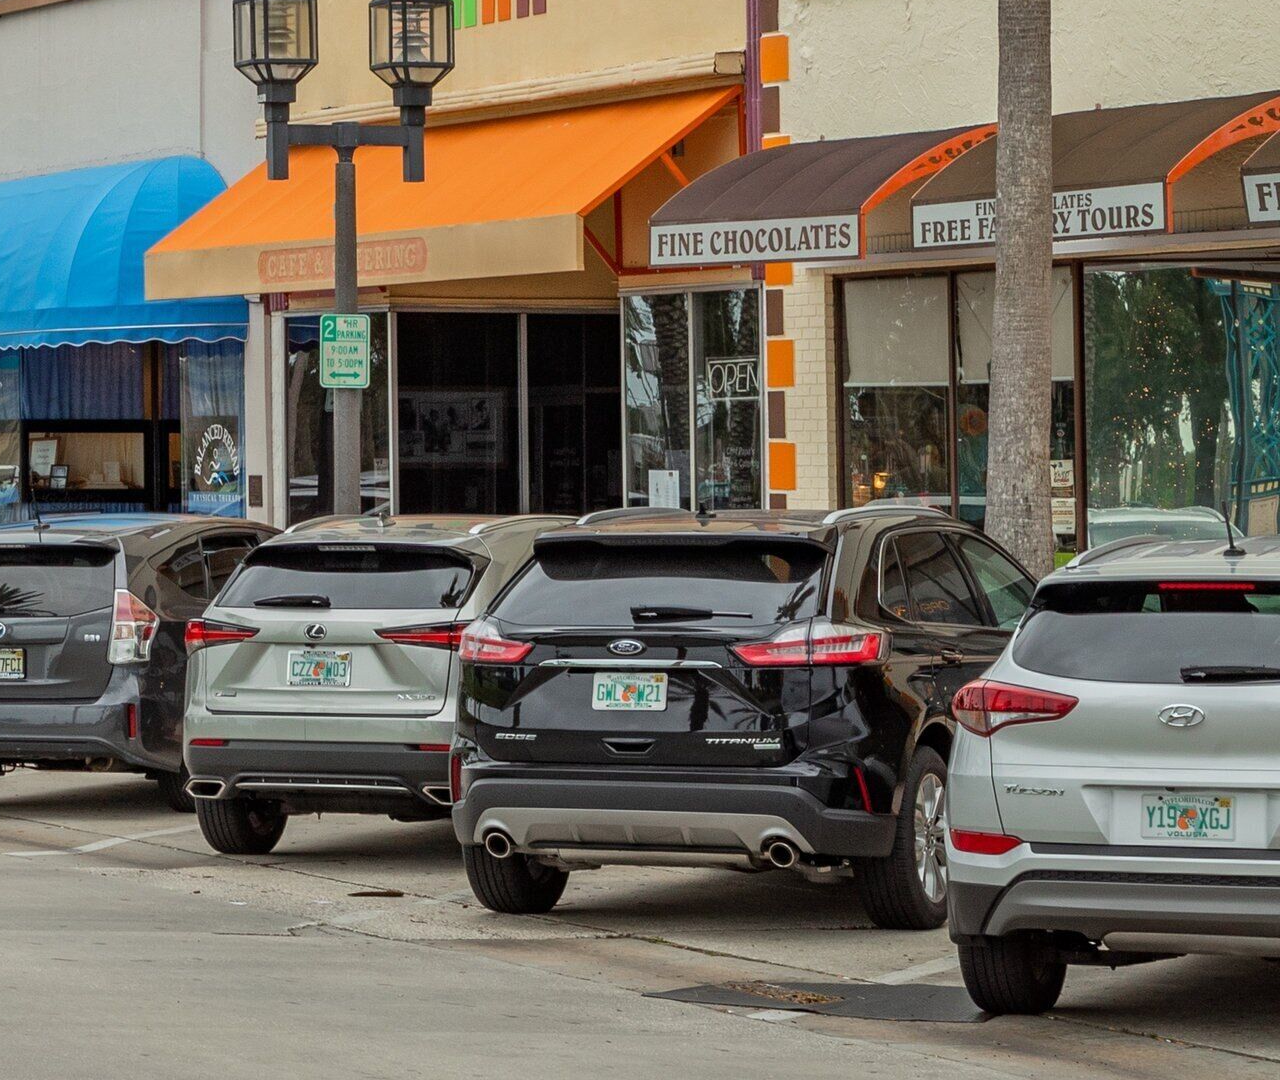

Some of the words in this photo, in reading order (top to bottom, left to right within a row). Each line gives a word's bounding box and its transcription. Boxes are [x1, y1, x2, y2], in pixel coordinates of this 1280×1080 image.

[1255, 181, 1280, 212] F
[975, 201, 996, 217] FIN
[921, 219, 971, 244] FREE
[1077, 203, 1154, 232] TOURS
[657, 232, 704, 258] FINE
[709, 223, 852, 256] CHOCOLATES
[267, 252, 309, 278] CAFE
[324, 320, 335, 338] 2
[346, 319, 359, 328] HR
[337, 330, 366, 340] PARKING
[710, 362, 759, 394] OPEN
[292, 661, 314, 677] CZZ
[326, 662, 346, 677] W03
[597, 683, 620, 701] GWL
[637, 684, 661, 702] W21
[495, 732, 538, 741] EDGE
[705, 737, 781, 745] TITANIUM
[1146, 806, 1178, 828] Y19
[1198, 807, 1230, 830] XGJ
[1167, 830, 1209, 838] VOLUSIA
